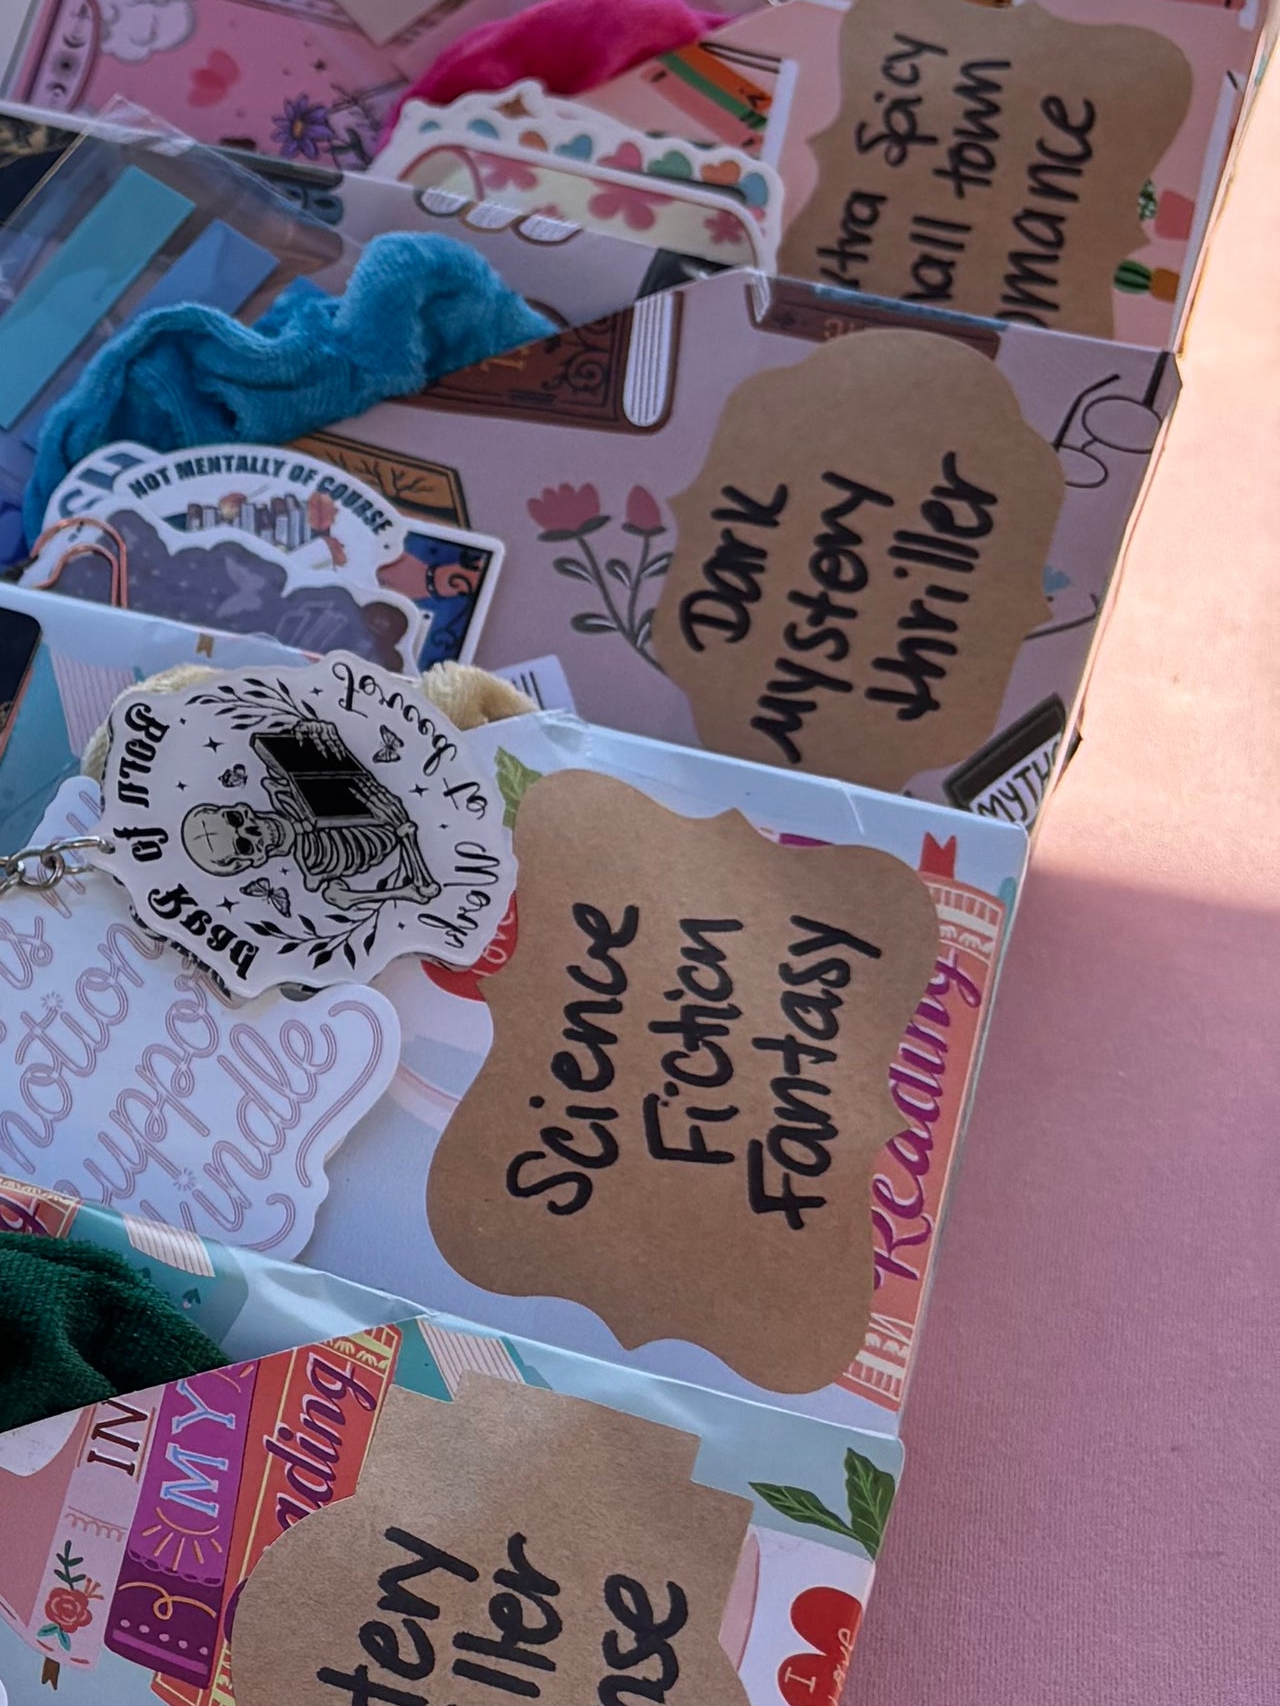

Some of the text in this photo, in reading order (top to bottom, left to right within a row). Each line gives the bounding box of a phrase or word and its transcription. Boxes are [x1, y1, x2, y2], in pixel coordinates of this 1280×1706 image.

[952, 55, 1013, 203] town
[128, 452, 395, 537] NOT MENTALLY OF COURSE
[680, 482, 790, 654] Dark
[865, 449, 999, 724] thriller
[750, 470, 896, 765] mystery
[505, 900, 640, 1215] Science
[641, 916, 745, 1166] Fiction
[748, 913, 882, 1232] Fantasy
[87, 1397, 149, 1477] IN
[160, 1379, 237, 1518] MY
